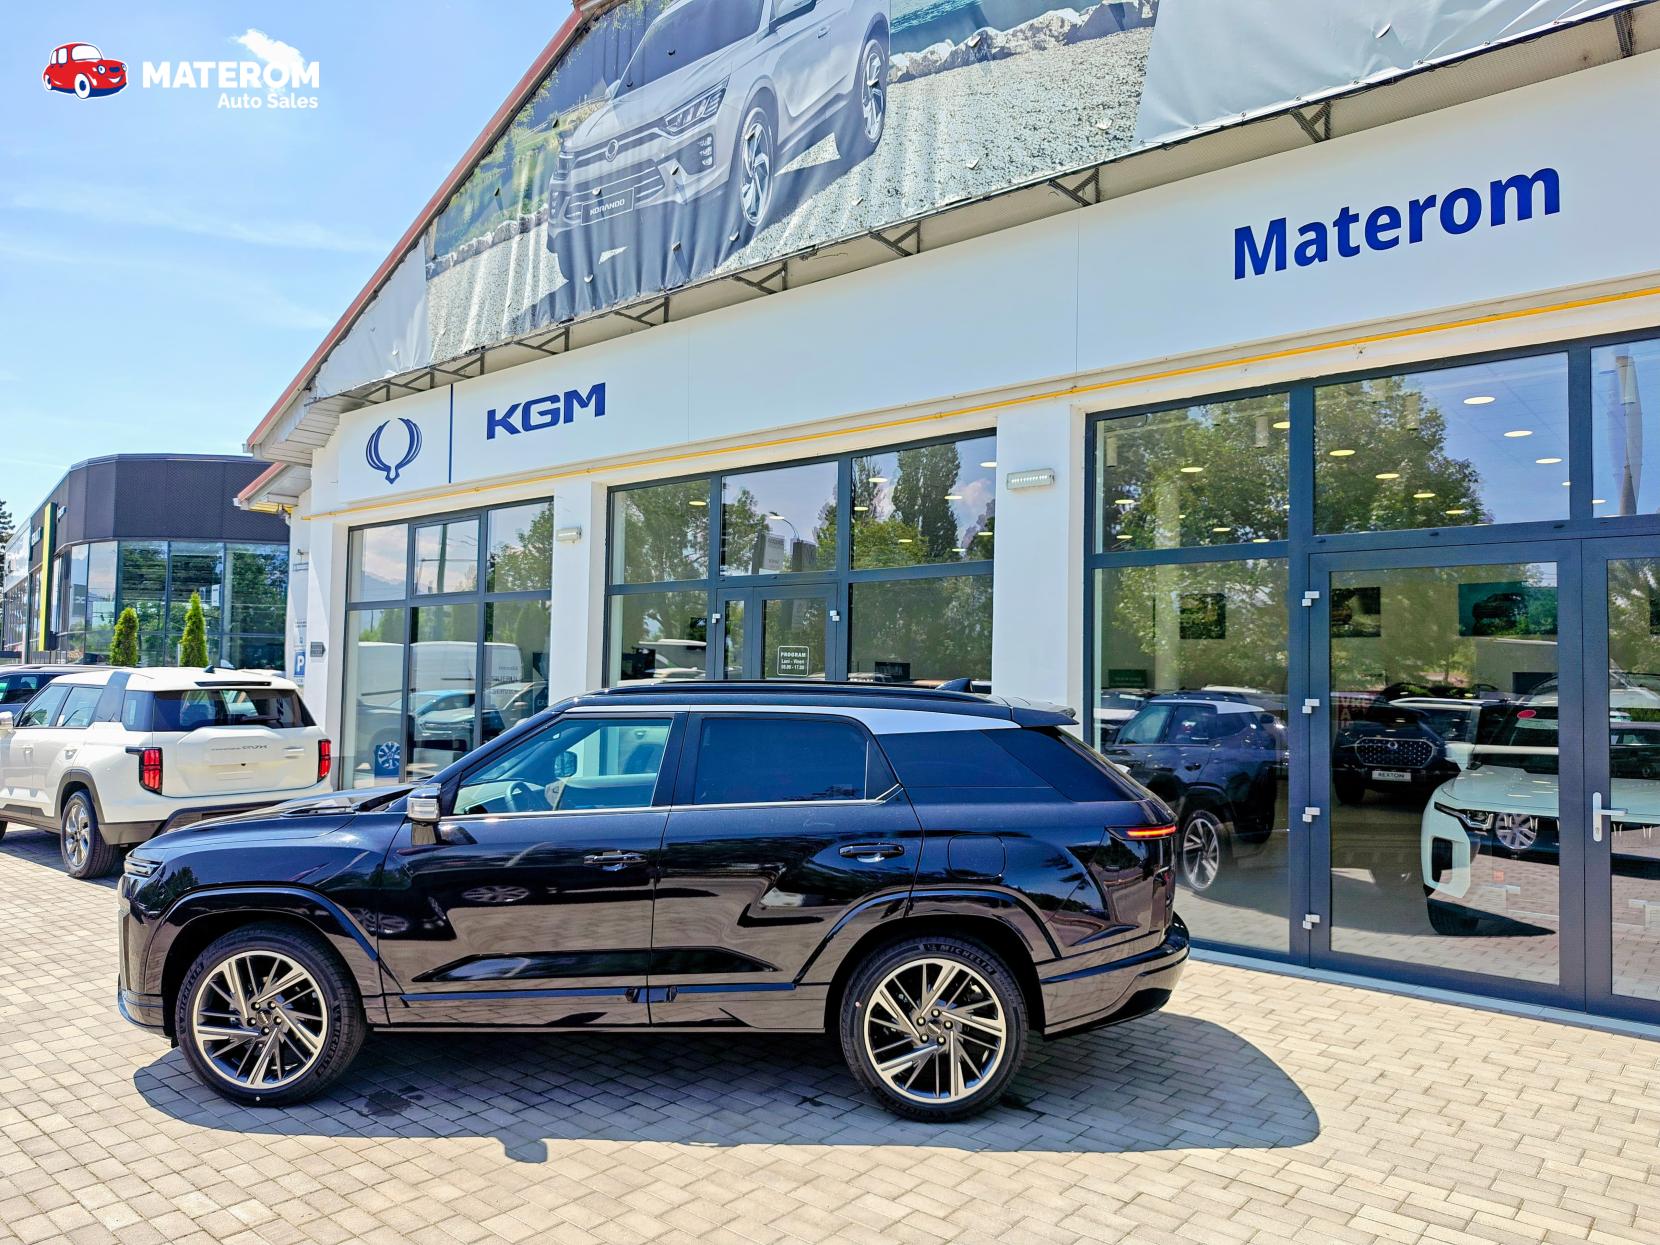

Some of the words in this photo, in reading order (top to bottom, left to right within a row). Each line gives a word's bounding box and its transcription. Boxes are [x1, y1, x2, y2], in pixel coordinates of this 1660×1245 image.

[589, 198, 625, 216] KORANDO
[1234, 166, 1561, 280] Materom
[486, 382, 606, 440] KGM
[939, 944, 994, 974] MICHELIN
